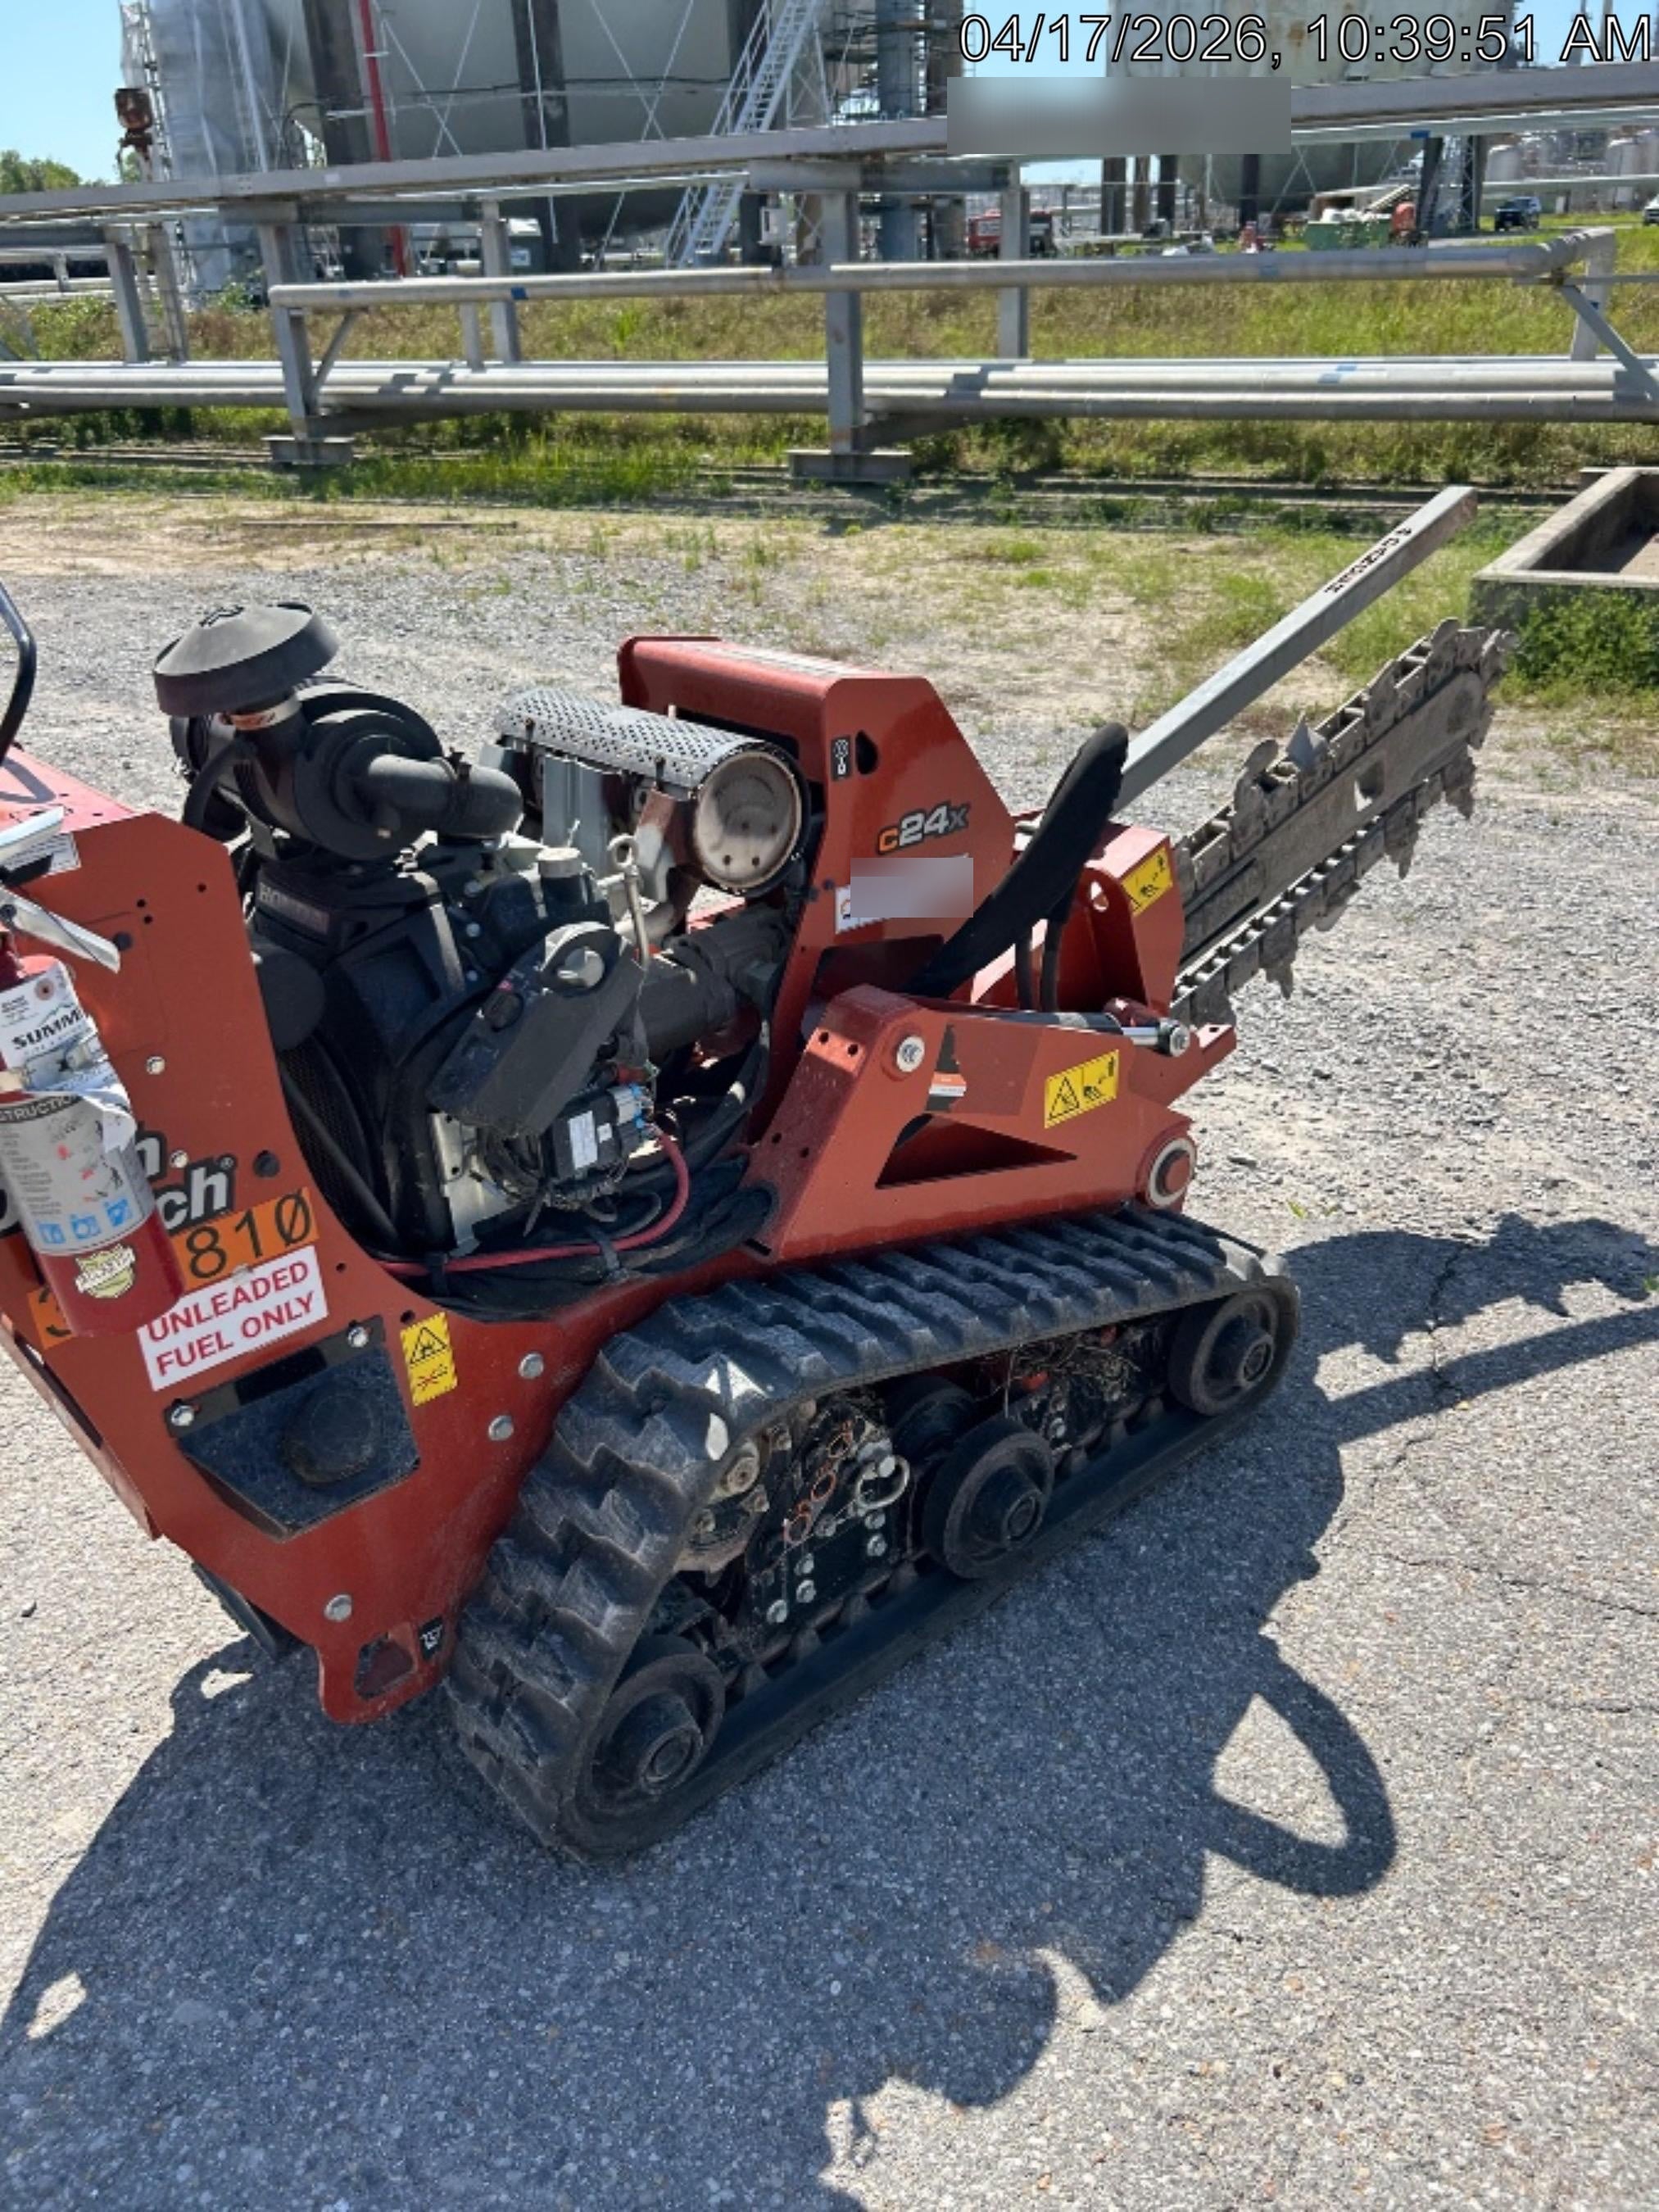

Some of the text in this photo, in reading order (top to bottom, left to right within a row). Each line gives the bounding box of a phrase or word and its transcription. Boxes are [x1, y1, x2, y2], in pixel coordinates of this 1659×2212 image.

[147, 1261, 309, 1342] UNLEADED
[156, 1290, 315, 1377] FUEL ONLY
